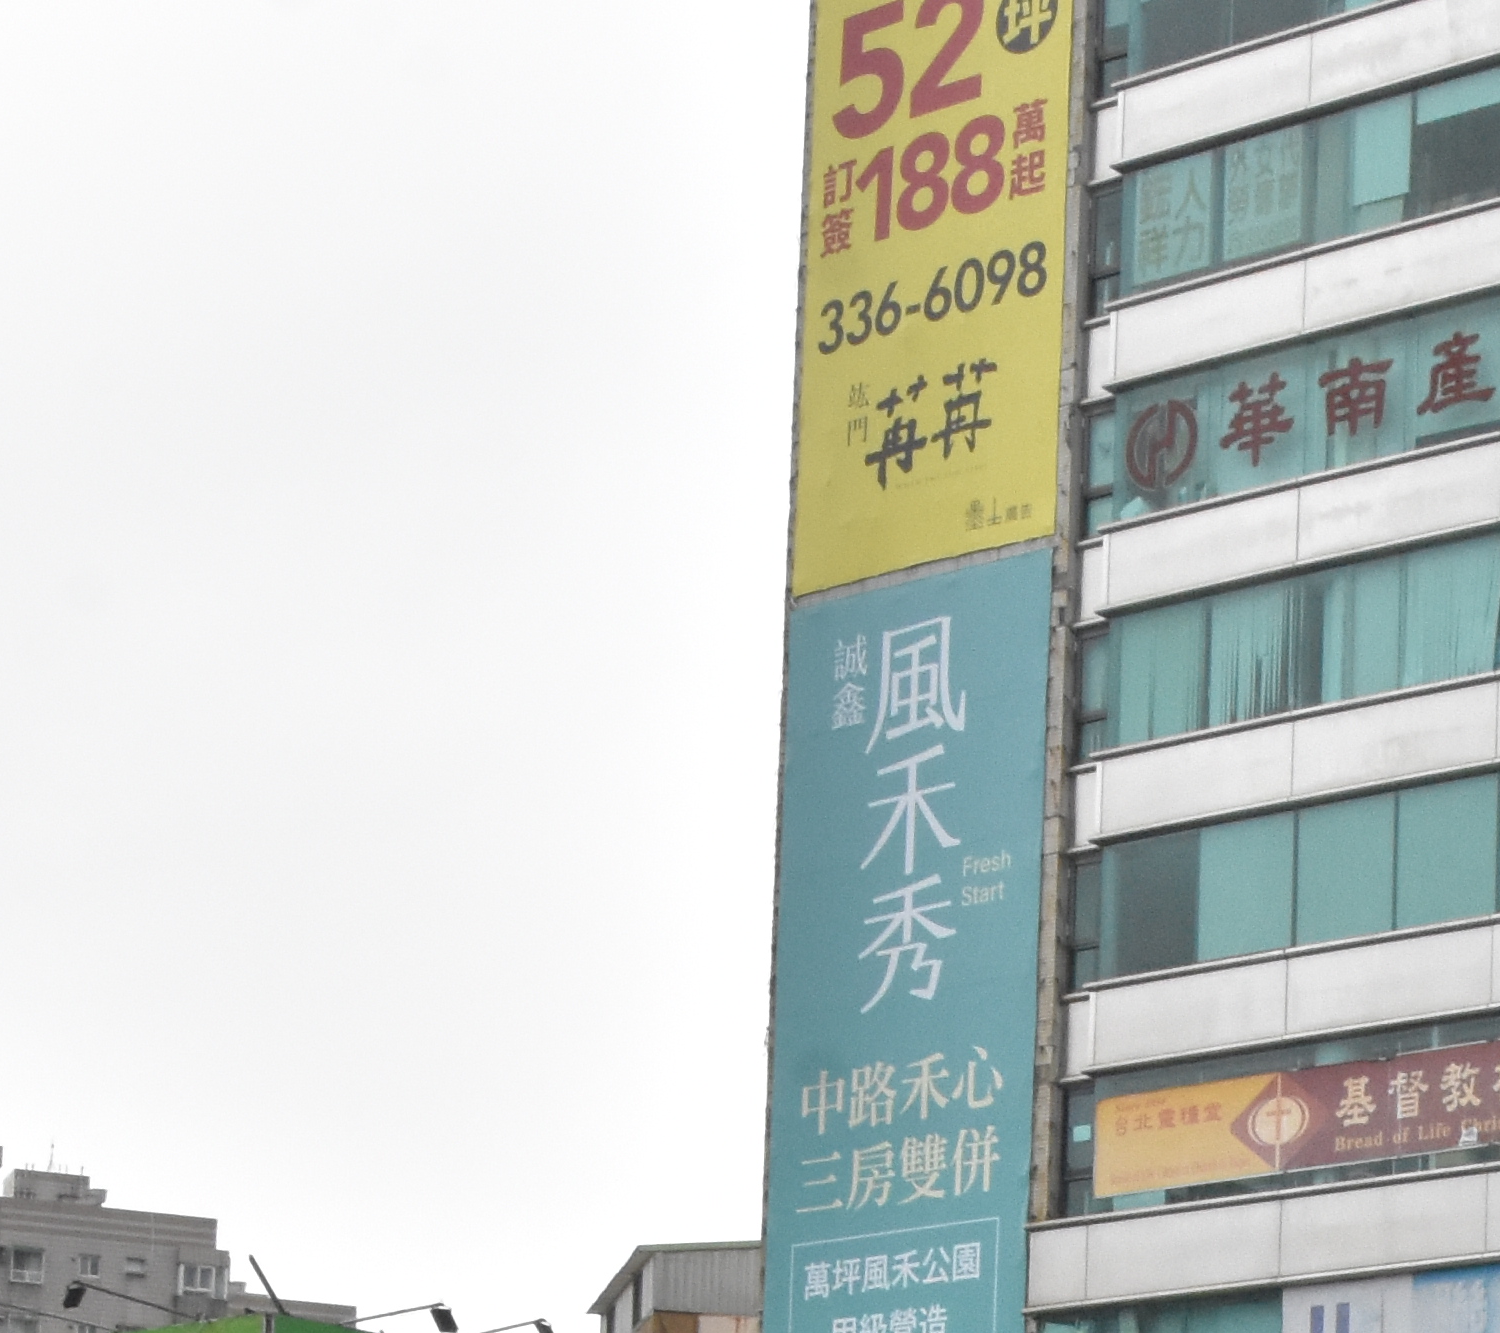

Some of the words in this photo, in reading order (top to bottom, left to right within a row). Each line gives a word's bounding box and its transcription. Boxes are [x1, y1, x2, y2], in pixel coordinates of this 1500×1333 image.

[831, 0, 984, 139] 52
[855, 113, 1006, 242] 188
[1008, 98, 1048, 201] 萬起
[817, 240, 1049, 355] 336-6098
[830, 633, 869, 731] 誠鑫
[857, 614, 967, 1014] 風禾秀
[960, 880, 1006, 907] Start
[961, 850, 1012, 878] Fresh
[800, 1045, 1004, 1136] 中路禾心
[1334, 1132, 1383, 1152] Bread
[1392, 1126, 1410, 1144] of
[1417, 1123, 1452, 1141] Life
[796, 1124, 1002, 1215] 三房雙併
[803, 1241, 983, 1302] 萬坪風禾公園
